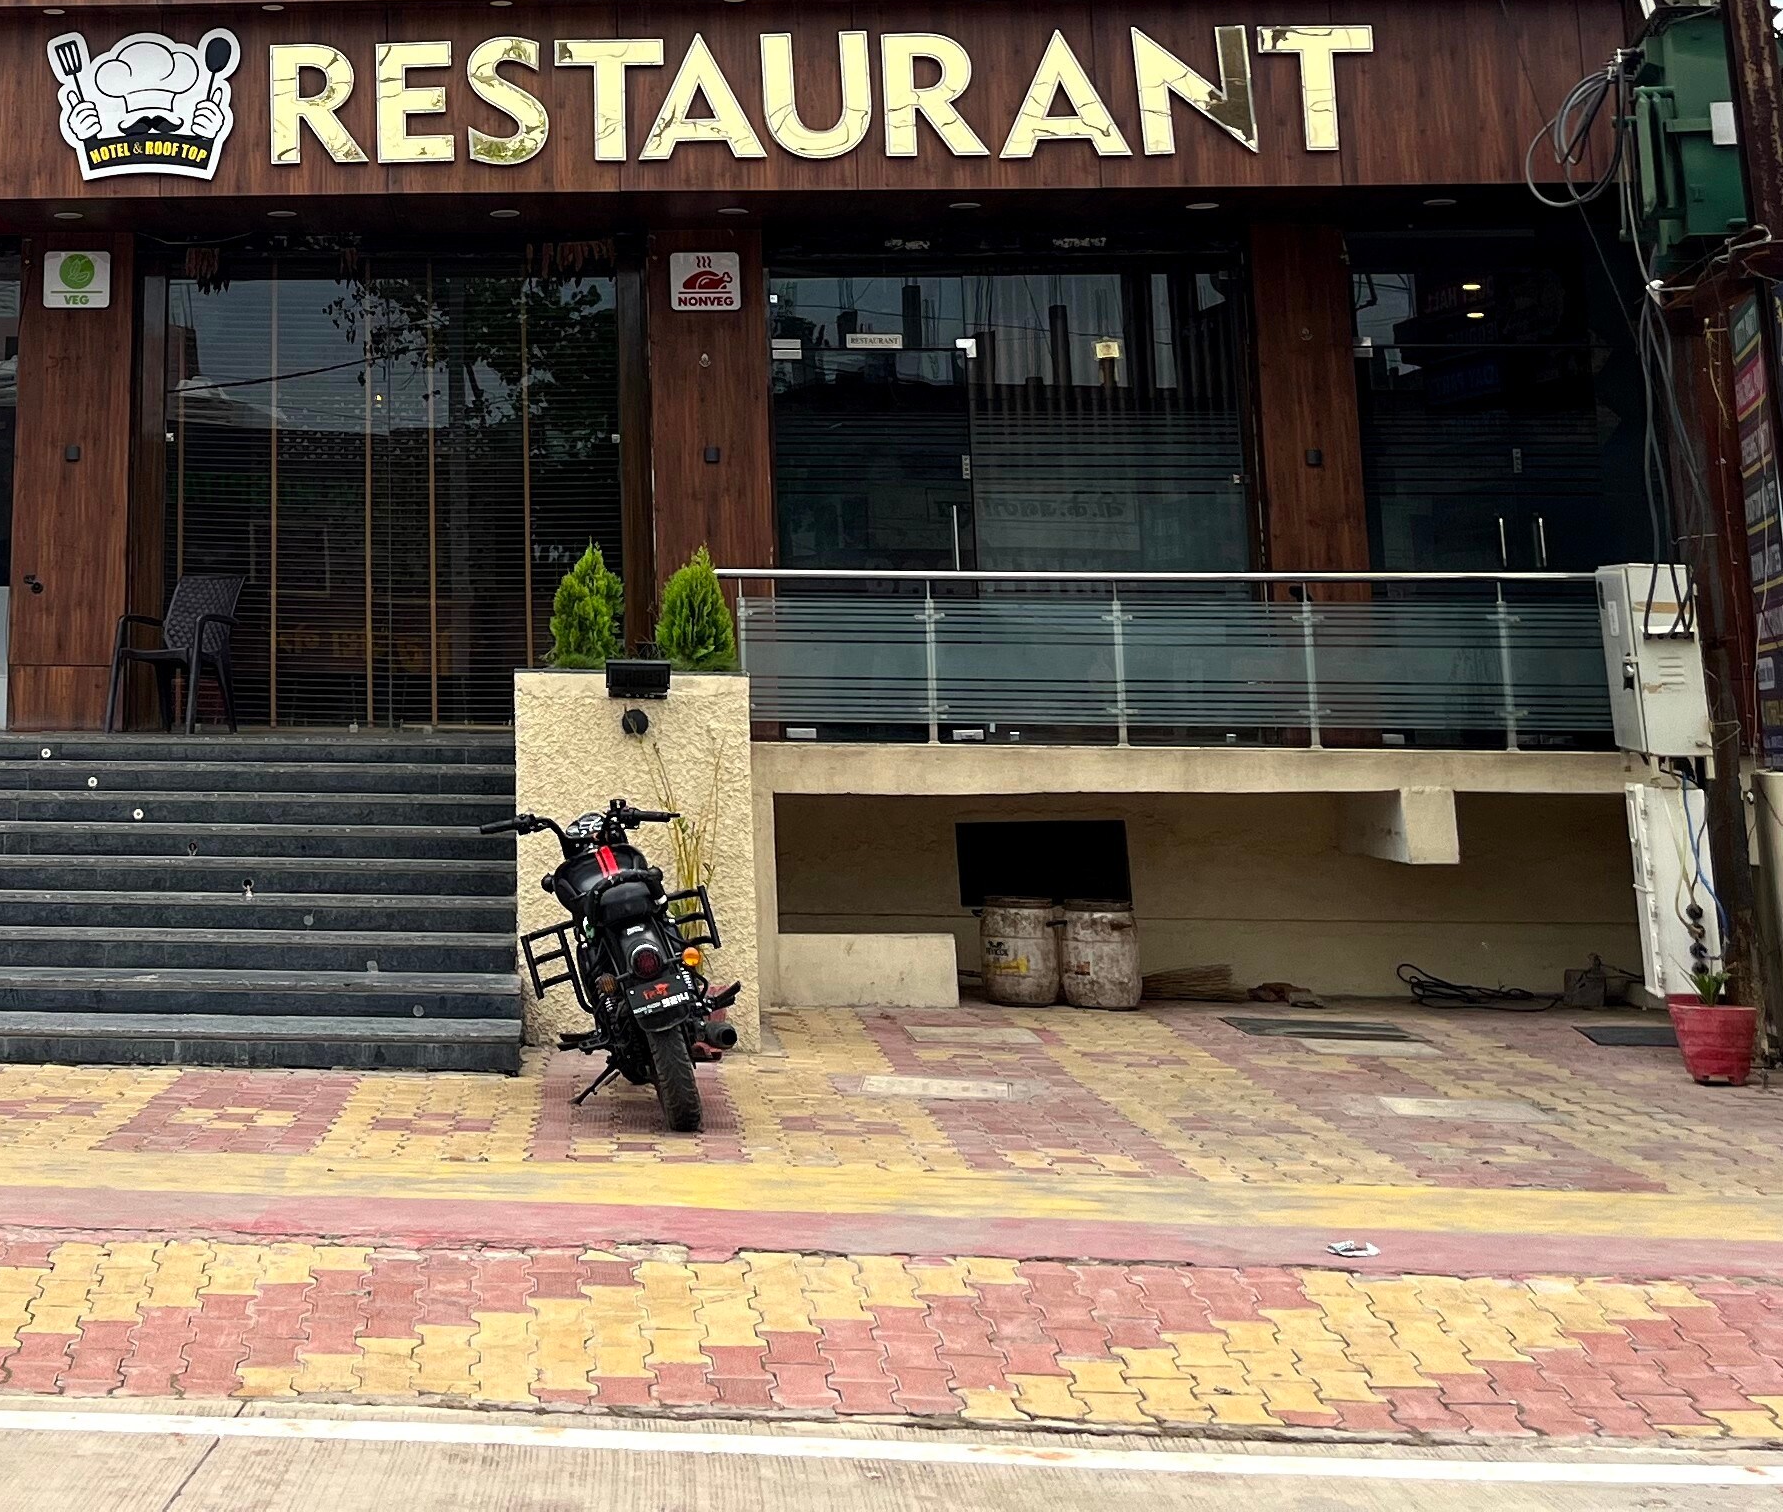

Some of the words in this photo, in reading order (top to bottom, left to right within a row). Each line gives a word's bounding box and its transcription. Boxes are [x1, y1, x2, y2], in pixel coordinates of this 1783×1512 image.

[269, 24, 1374, 166] RESTAURANT
[89, 142, 131, 164] HOTEL
[133, 141, 143, 154] &
[145, 140, 179, 156] ROOF
[181, 143, 208, 162] TOP
[63, 294, 90, 306] VEG
[677, 296, 735, 307] NONVEG
[850, 336, 899, 345] RESTAURANT
